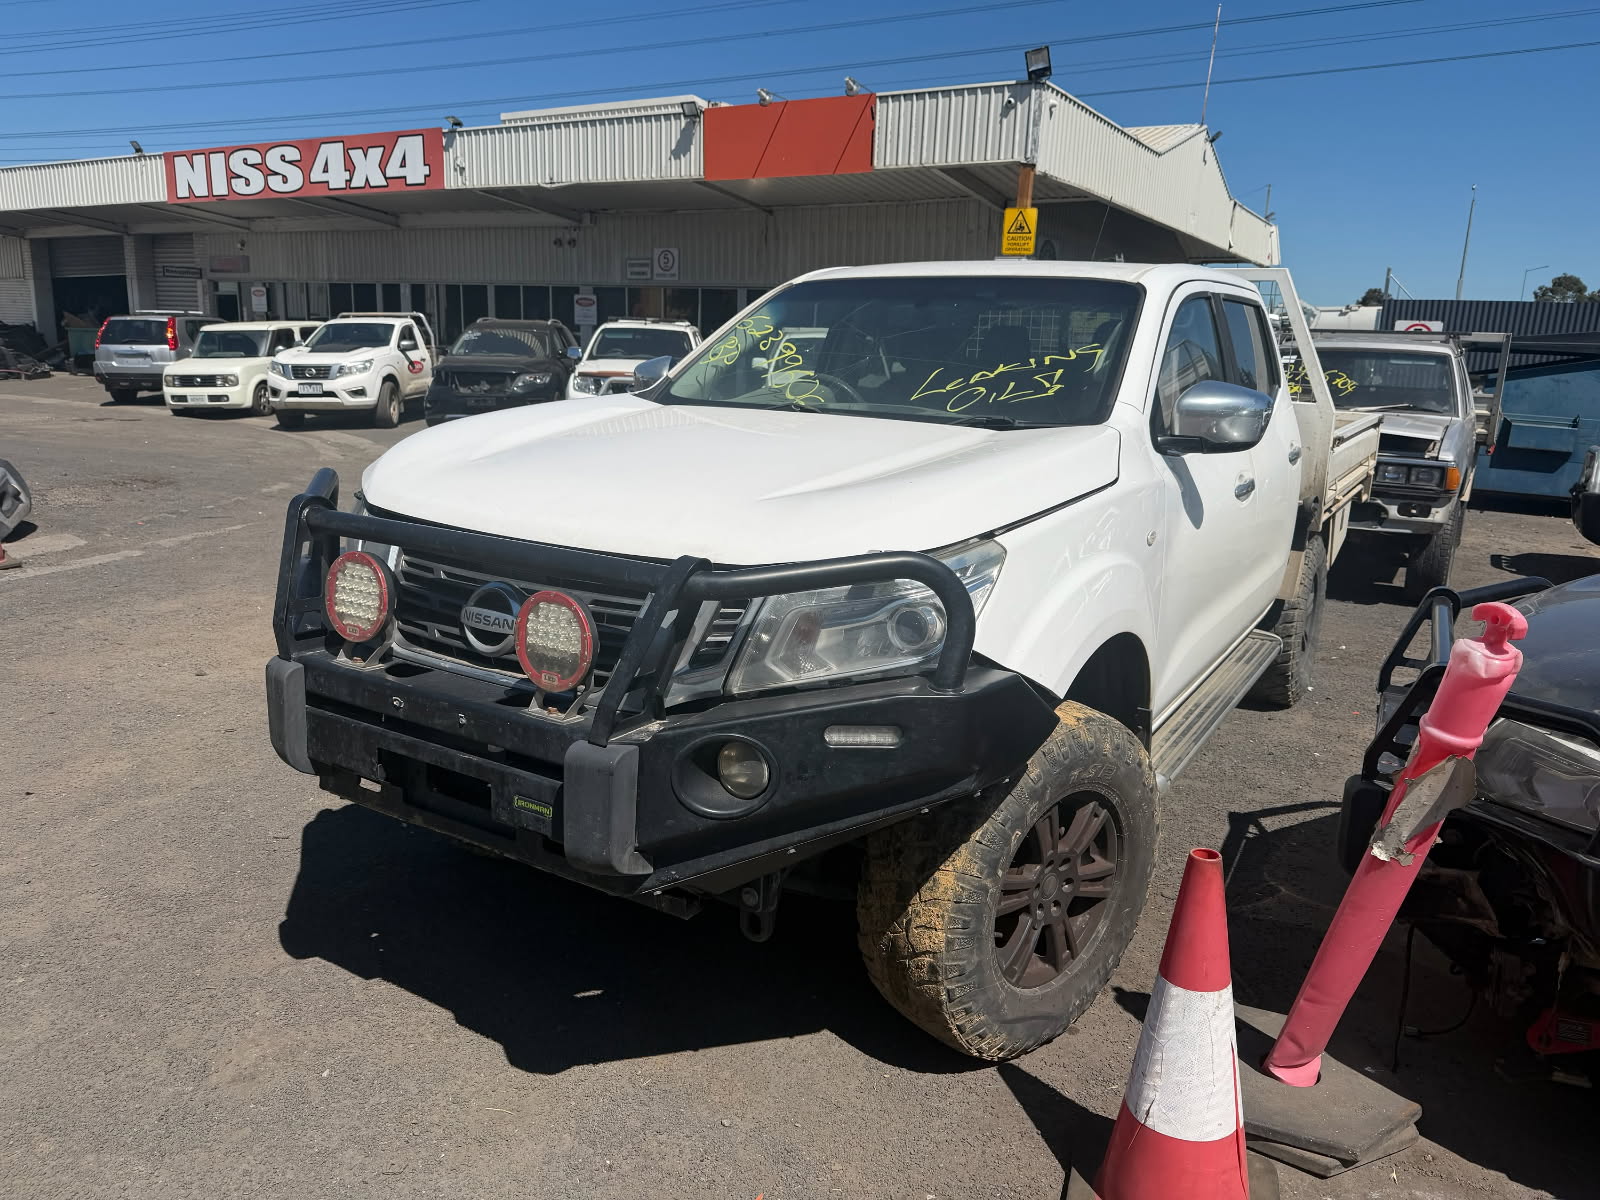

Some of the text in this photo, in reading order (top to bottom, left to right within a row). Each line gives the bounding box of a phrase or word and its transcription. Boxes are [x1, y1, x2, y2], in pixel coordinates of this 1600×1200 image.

[173, 133, 431, 199] NISS 4x4
[663, 253, 670, 264] 5
[463, 608, 515, 631] NISSAN
[544, 674, 557, 683] LED
[517, 799, 551, 817] IRONMAN
